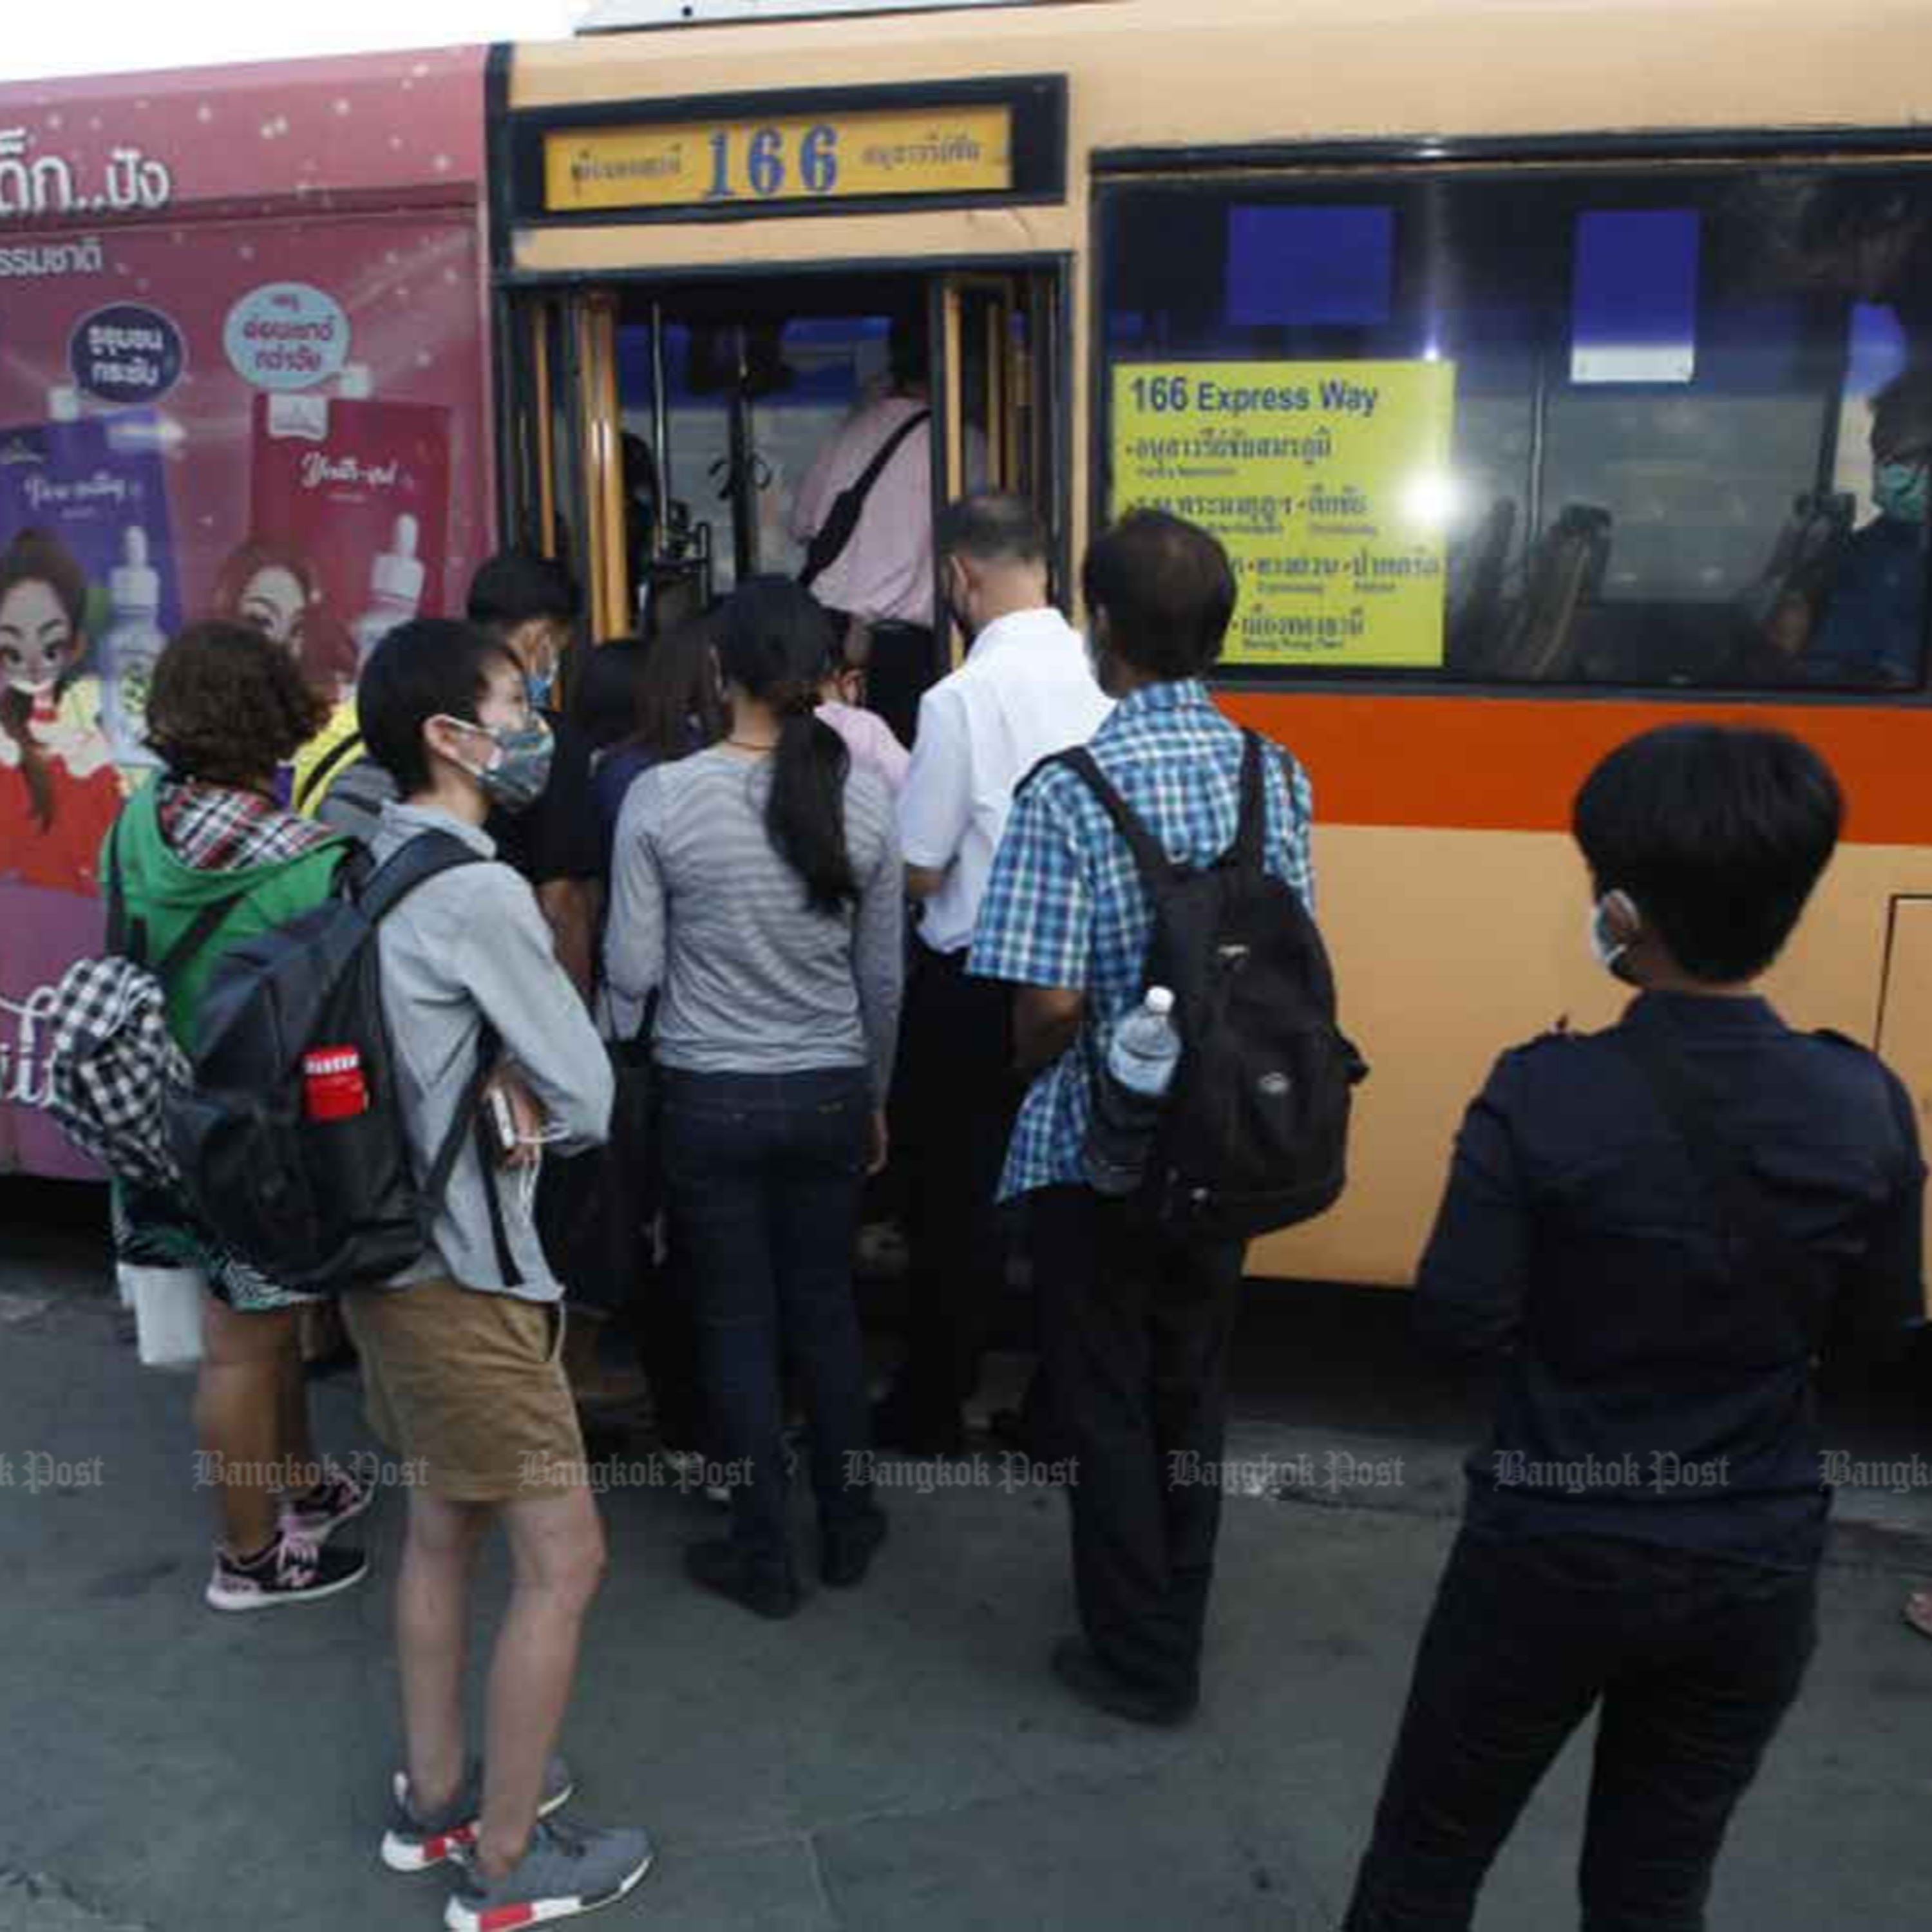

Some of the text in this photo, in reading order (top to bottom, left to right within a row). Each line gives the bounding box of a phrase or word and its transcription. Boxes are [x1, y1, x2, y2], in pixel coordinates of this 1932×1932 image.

[704, 126, 840, 200] 166
[1130, 376, 1379, 417] 166 Express Way
